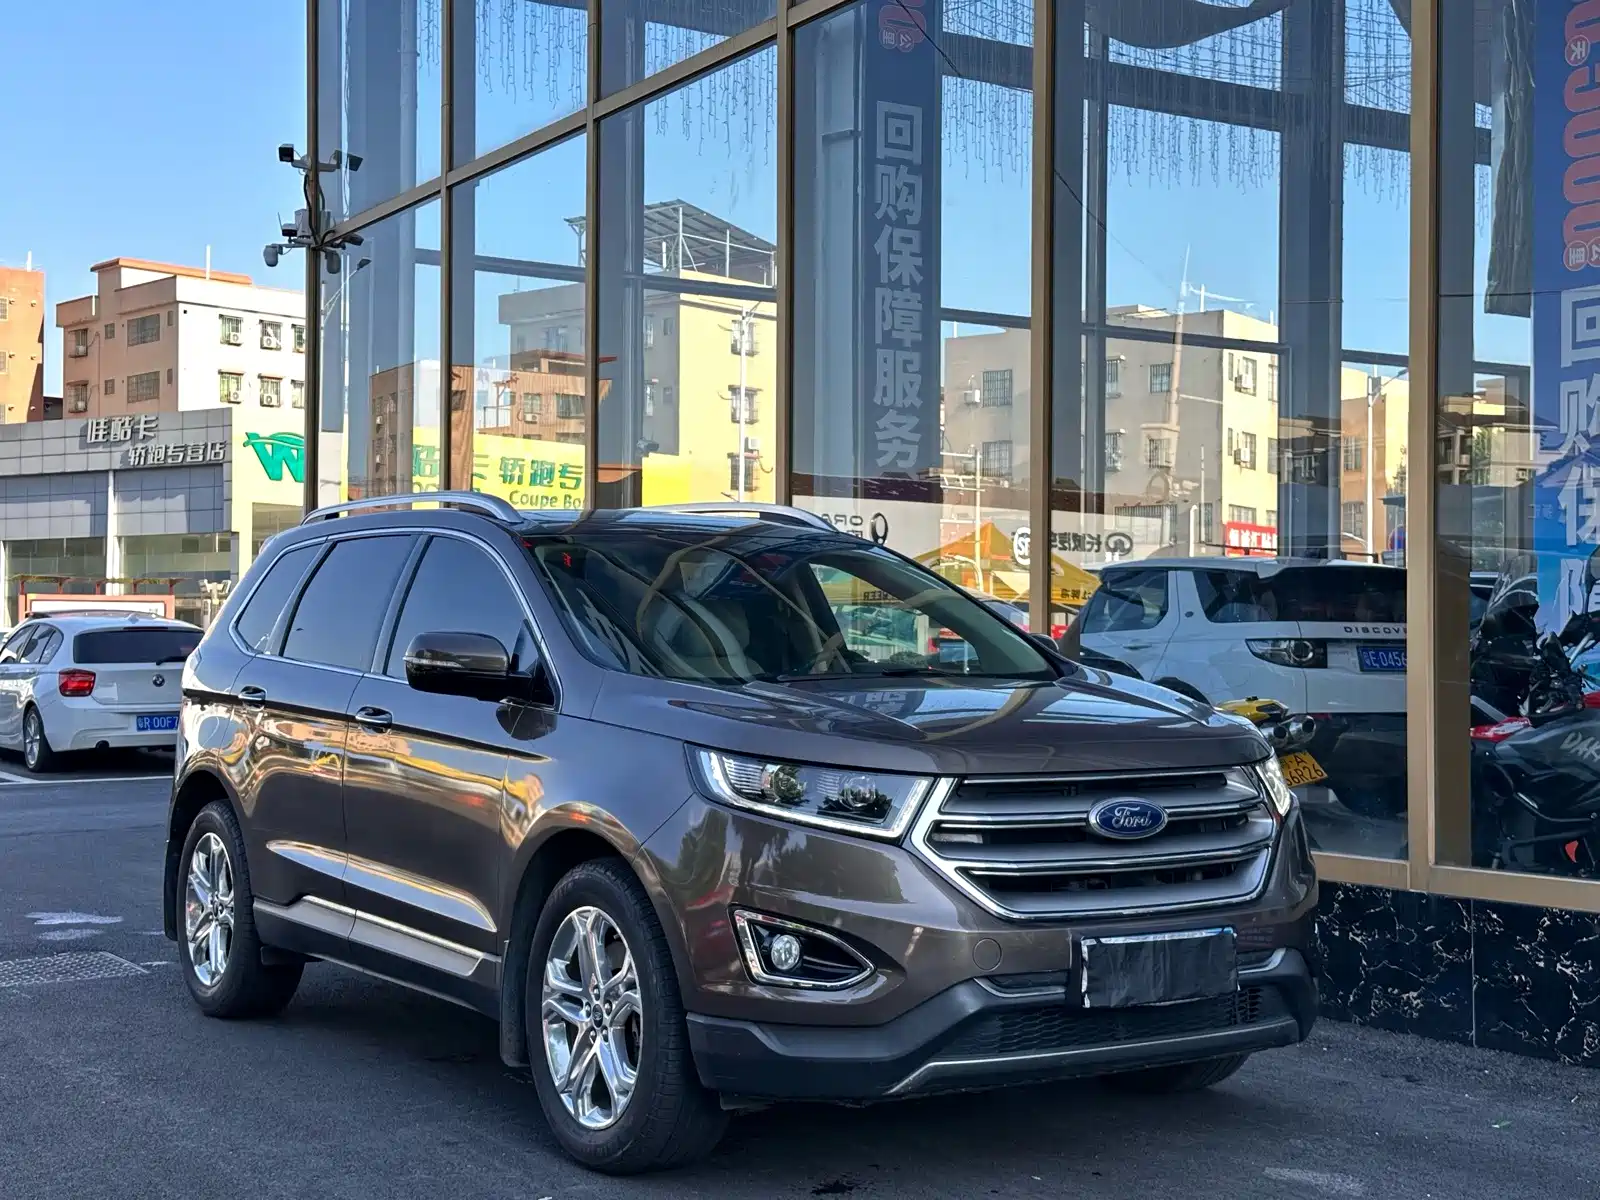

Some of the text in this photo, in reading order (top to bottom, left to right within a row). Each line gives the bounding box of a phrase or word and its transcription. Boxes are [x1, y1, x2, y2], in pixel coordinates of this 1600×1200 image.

[873, 100, 923, 468] 回购保障服务
[87, 415, 158, 443] 哇酷卡
[128, 440, 226, 466] 轿跑专营店
[498, 456, 583, 490] 轿跑专
[509, 490, 585, 509] Coupe Bo
[1112, 806, 1152, 828] Ford
